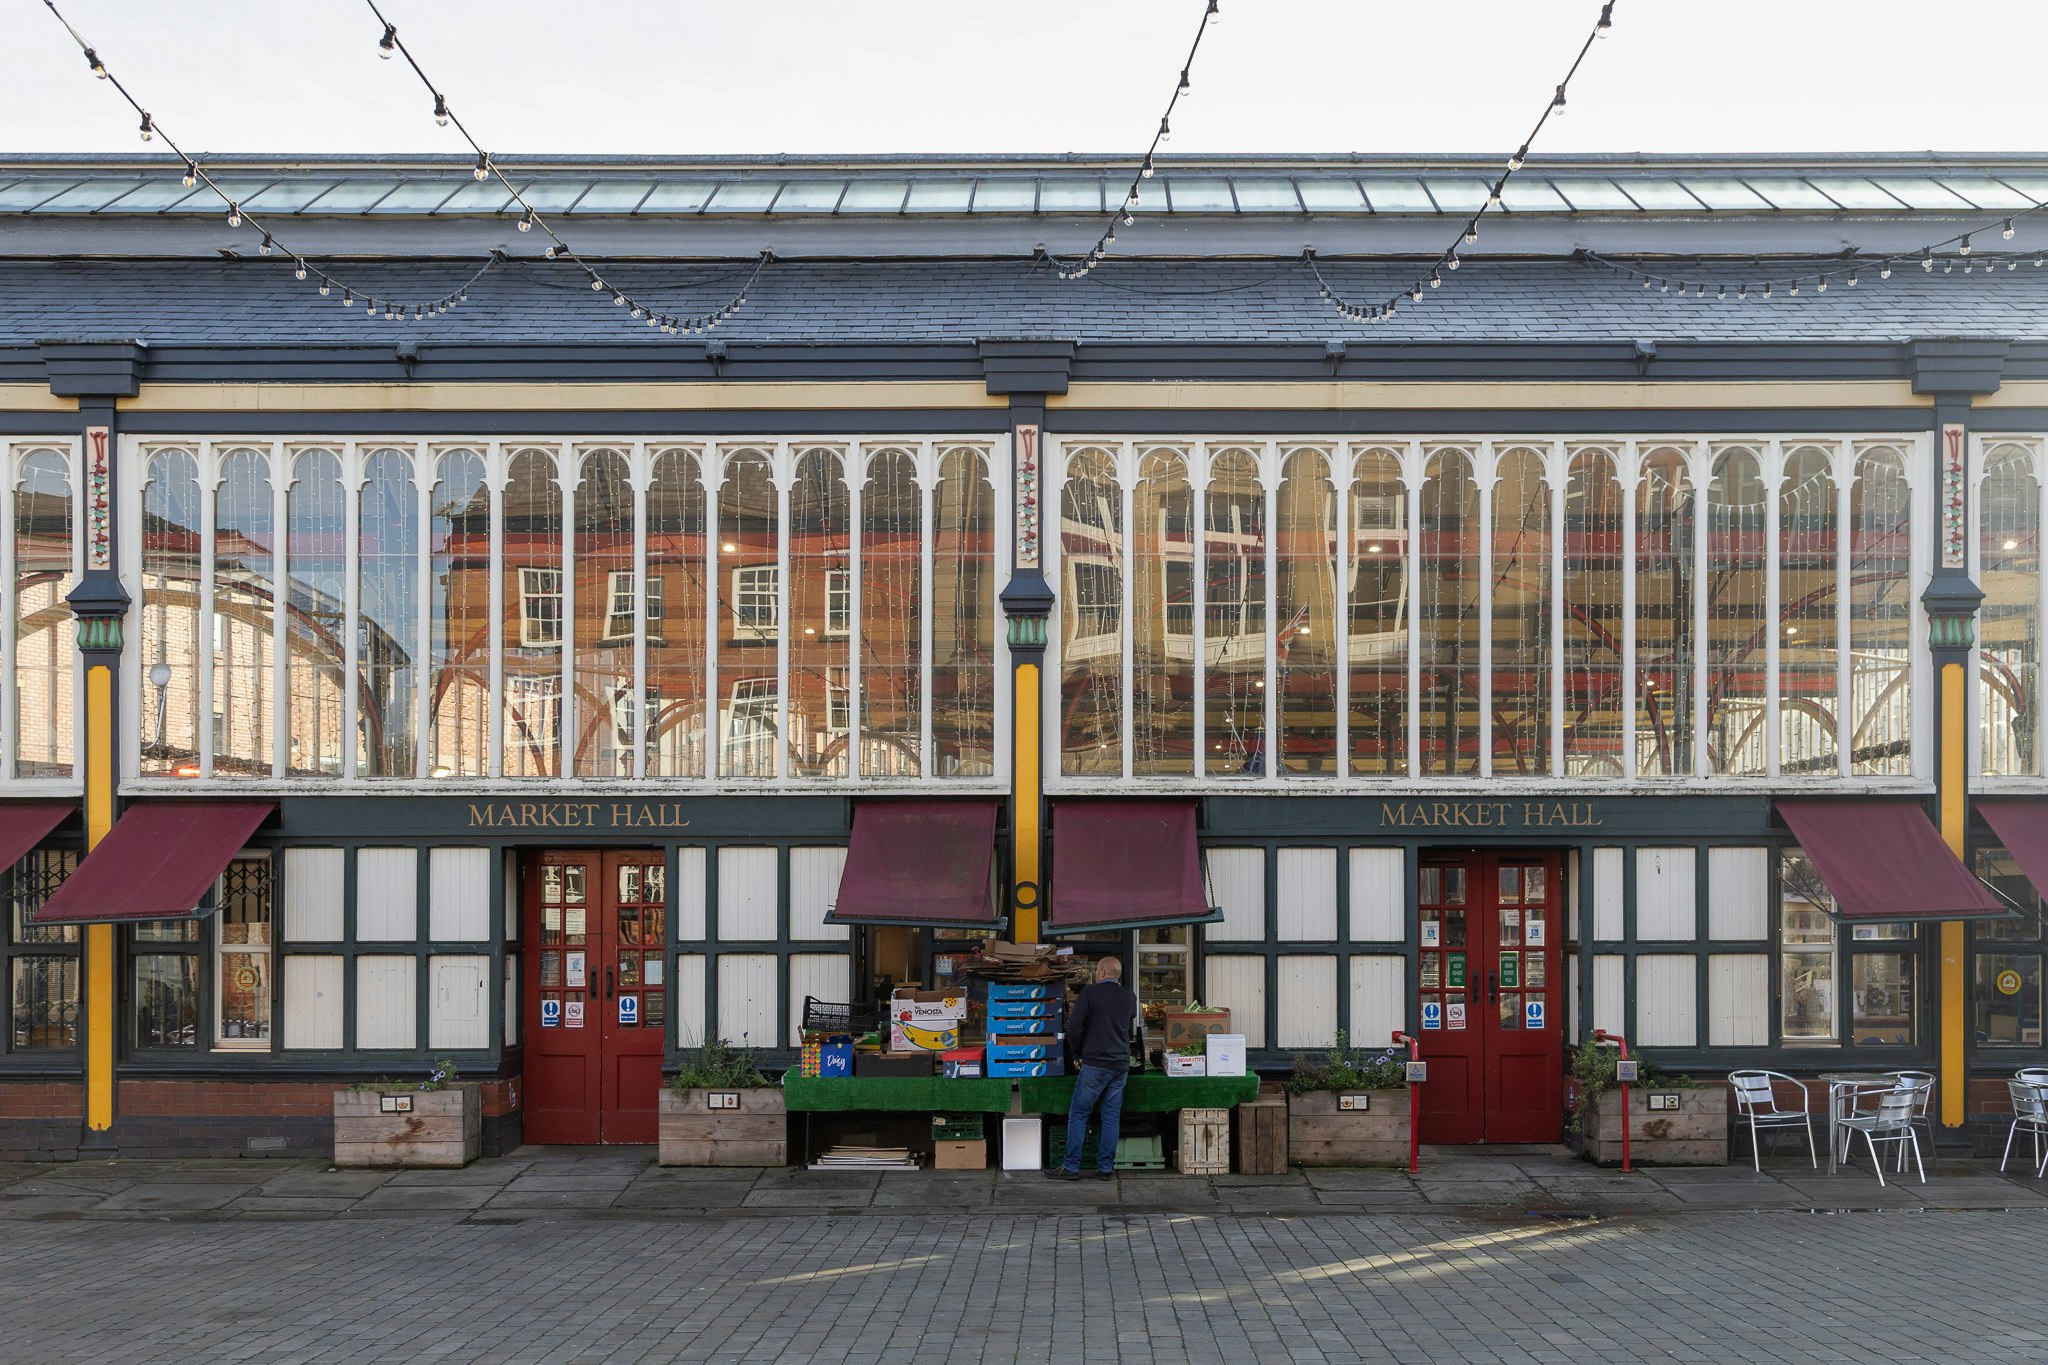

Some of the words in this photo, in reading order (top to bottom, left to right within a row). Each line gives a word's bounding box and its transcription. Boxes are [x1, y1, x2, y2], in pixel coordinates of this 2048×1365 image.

[468, 803, 600, 827] MARKET
[611, 803, 690, 827] HALL
[1379, 802, 1513, 826] MARKET
[1522, 802, 1603, 826] HALL
[914, 1008, 944, 1016] VENOSTA
[826, 1054, 847, 1071] Daisy
